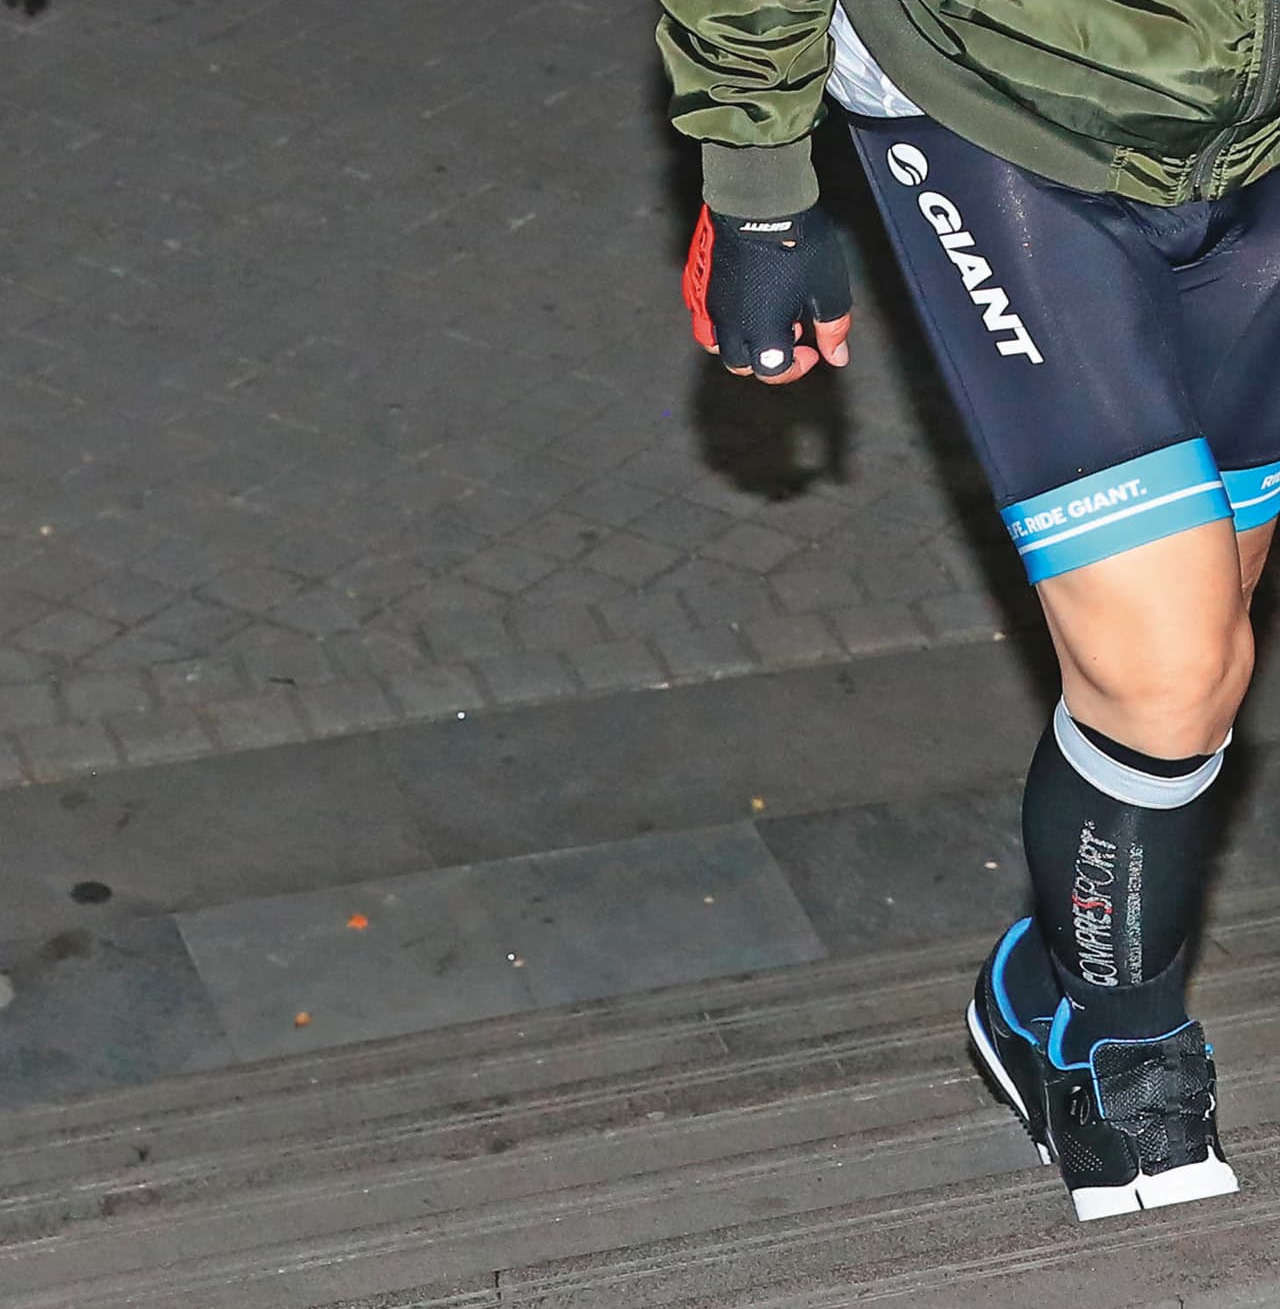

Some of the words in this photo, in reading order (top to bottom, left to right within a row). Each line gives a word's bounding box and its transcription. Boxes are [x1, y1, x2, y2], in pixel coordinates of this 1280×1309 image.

[917, 191, 1044, 365] GIANT
[1024, 505, 1067, 533] RIDE
[1068, 479, 1147, 518] GIANT.
